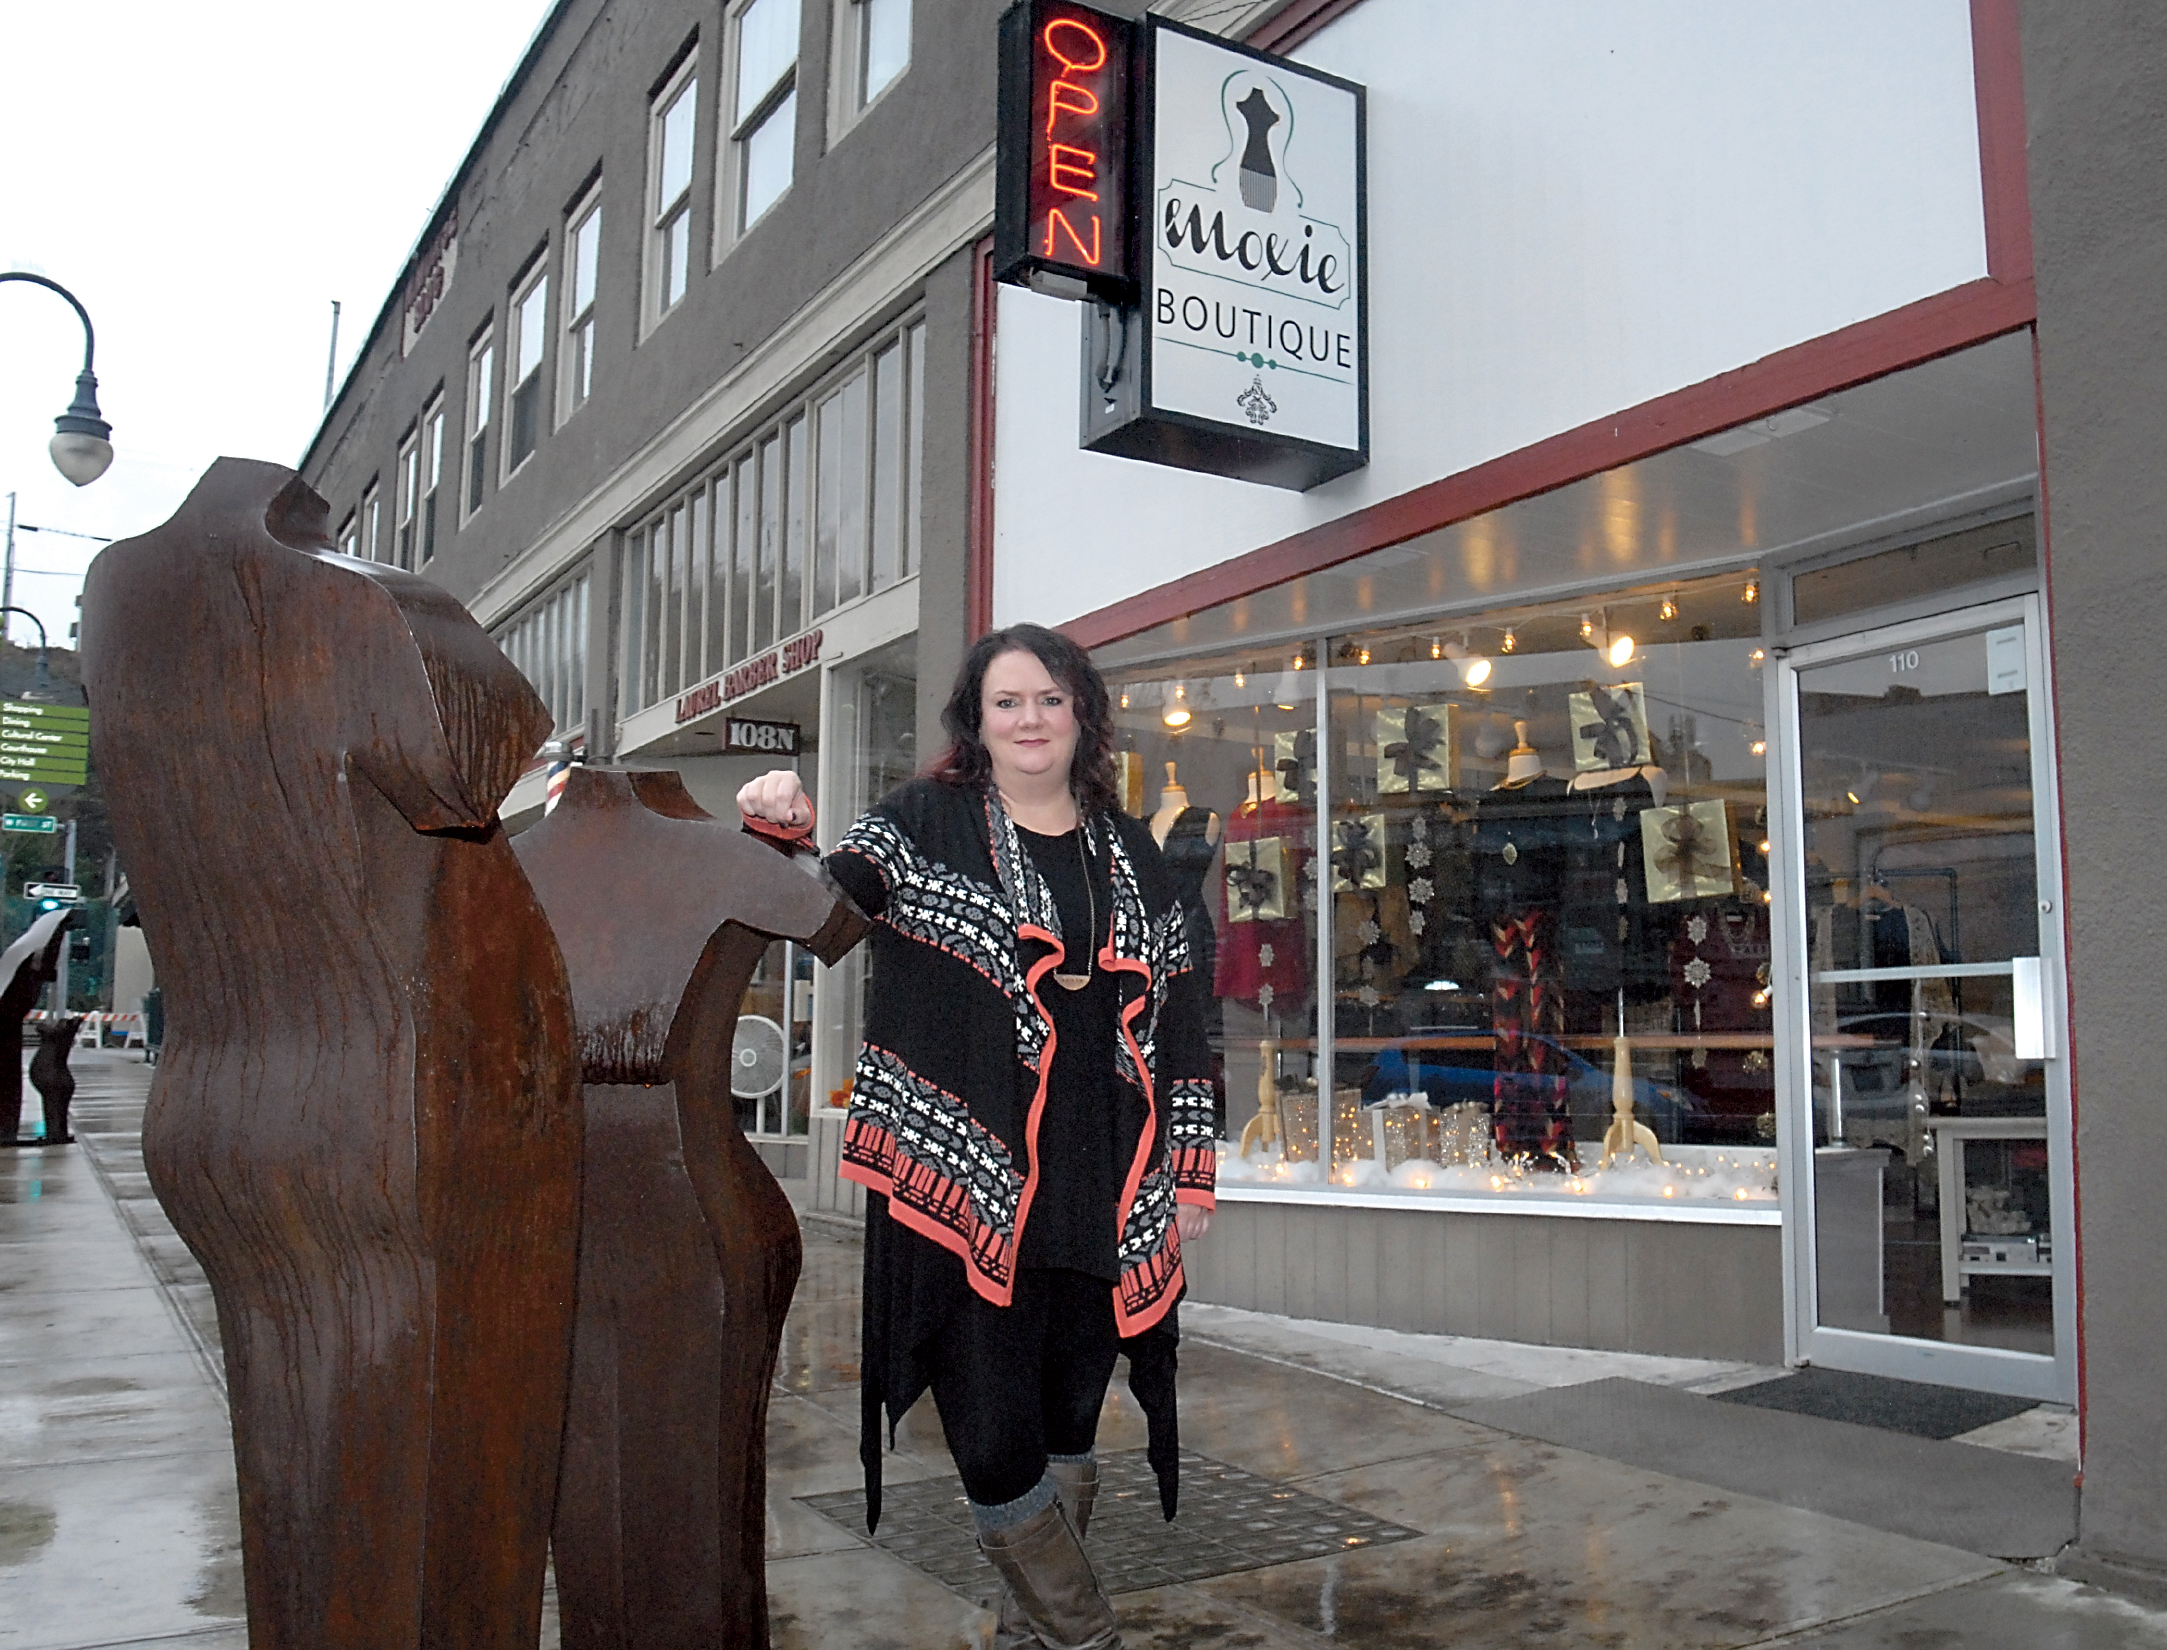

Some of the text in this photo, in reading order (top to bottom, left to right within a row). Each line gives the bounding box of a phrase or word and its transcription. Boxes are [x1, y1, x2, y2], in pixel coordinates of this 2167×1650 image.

[1043, 17, 1107, 267] OPEN
[1157, 288, 1352, 369] BOUTIQUE
[722, 652, 779, 701] BARBER
[782, 628, 824, 673] SHOP
[1889, 651, 1920, 673] 110
[3, 702, 44, 716] Shopping
[2, 716, 31, 728] Dining
[1, 729, 63, 742] Cultural Center
[729, 722, 795, 751] 108N
[0, 743, 48, 754] Courthouse
[0, 756, 36, 767] City Hall
